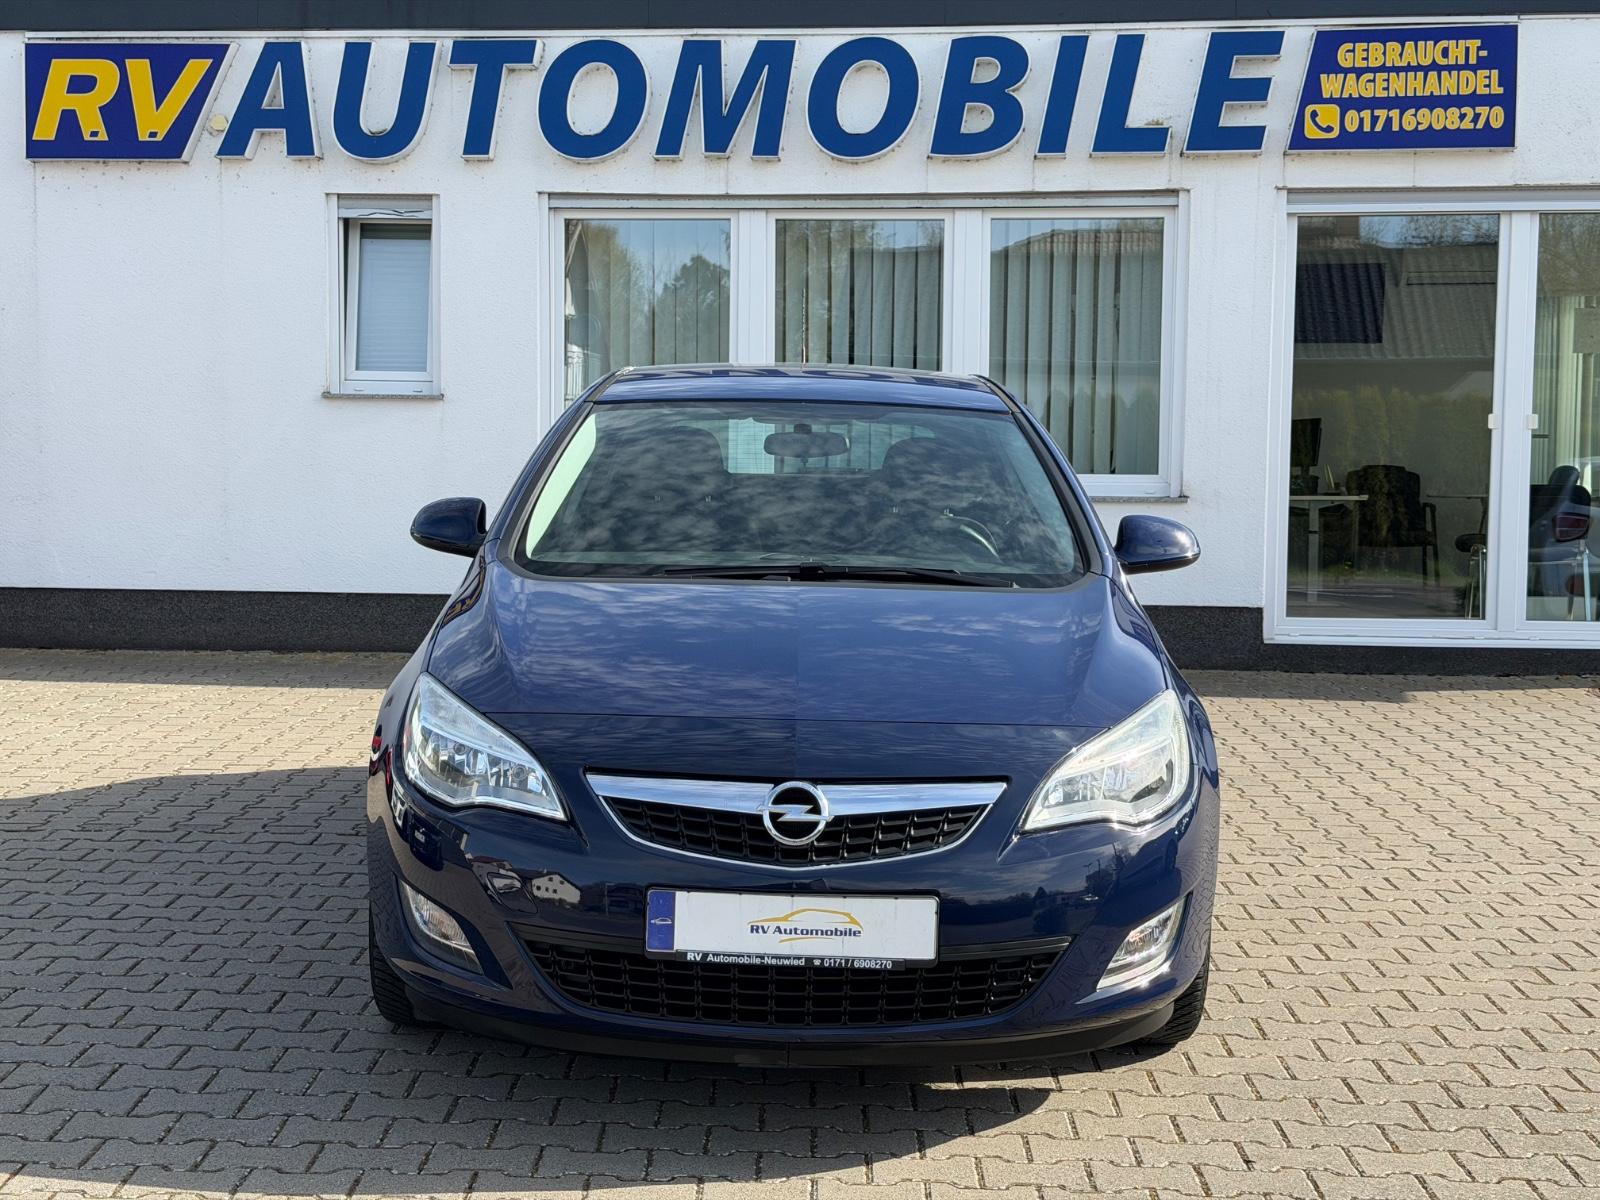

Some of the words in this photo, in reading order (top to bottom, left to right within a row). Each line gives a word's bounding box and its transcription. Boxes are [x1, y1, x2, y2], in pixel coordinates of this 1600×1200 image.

[1337, 40, 1488, 68] GEBRAUCHT-
[216, 31, 1285, 161] AUTOMOBILE
[1320, 69, 1504, 98] WAGENHANDEL
[1344, 106, 1505, 132] 01716908270
[750, 924, 771, 935] RV
[773, 925, 862, 937] Automobile
[687, 952, 703, 961] RV
[706, 954, 805, 966] Automobile-Neuwied
[823, 958, 846, 967] 0171
[853, 959, 893, 969] 6908270
